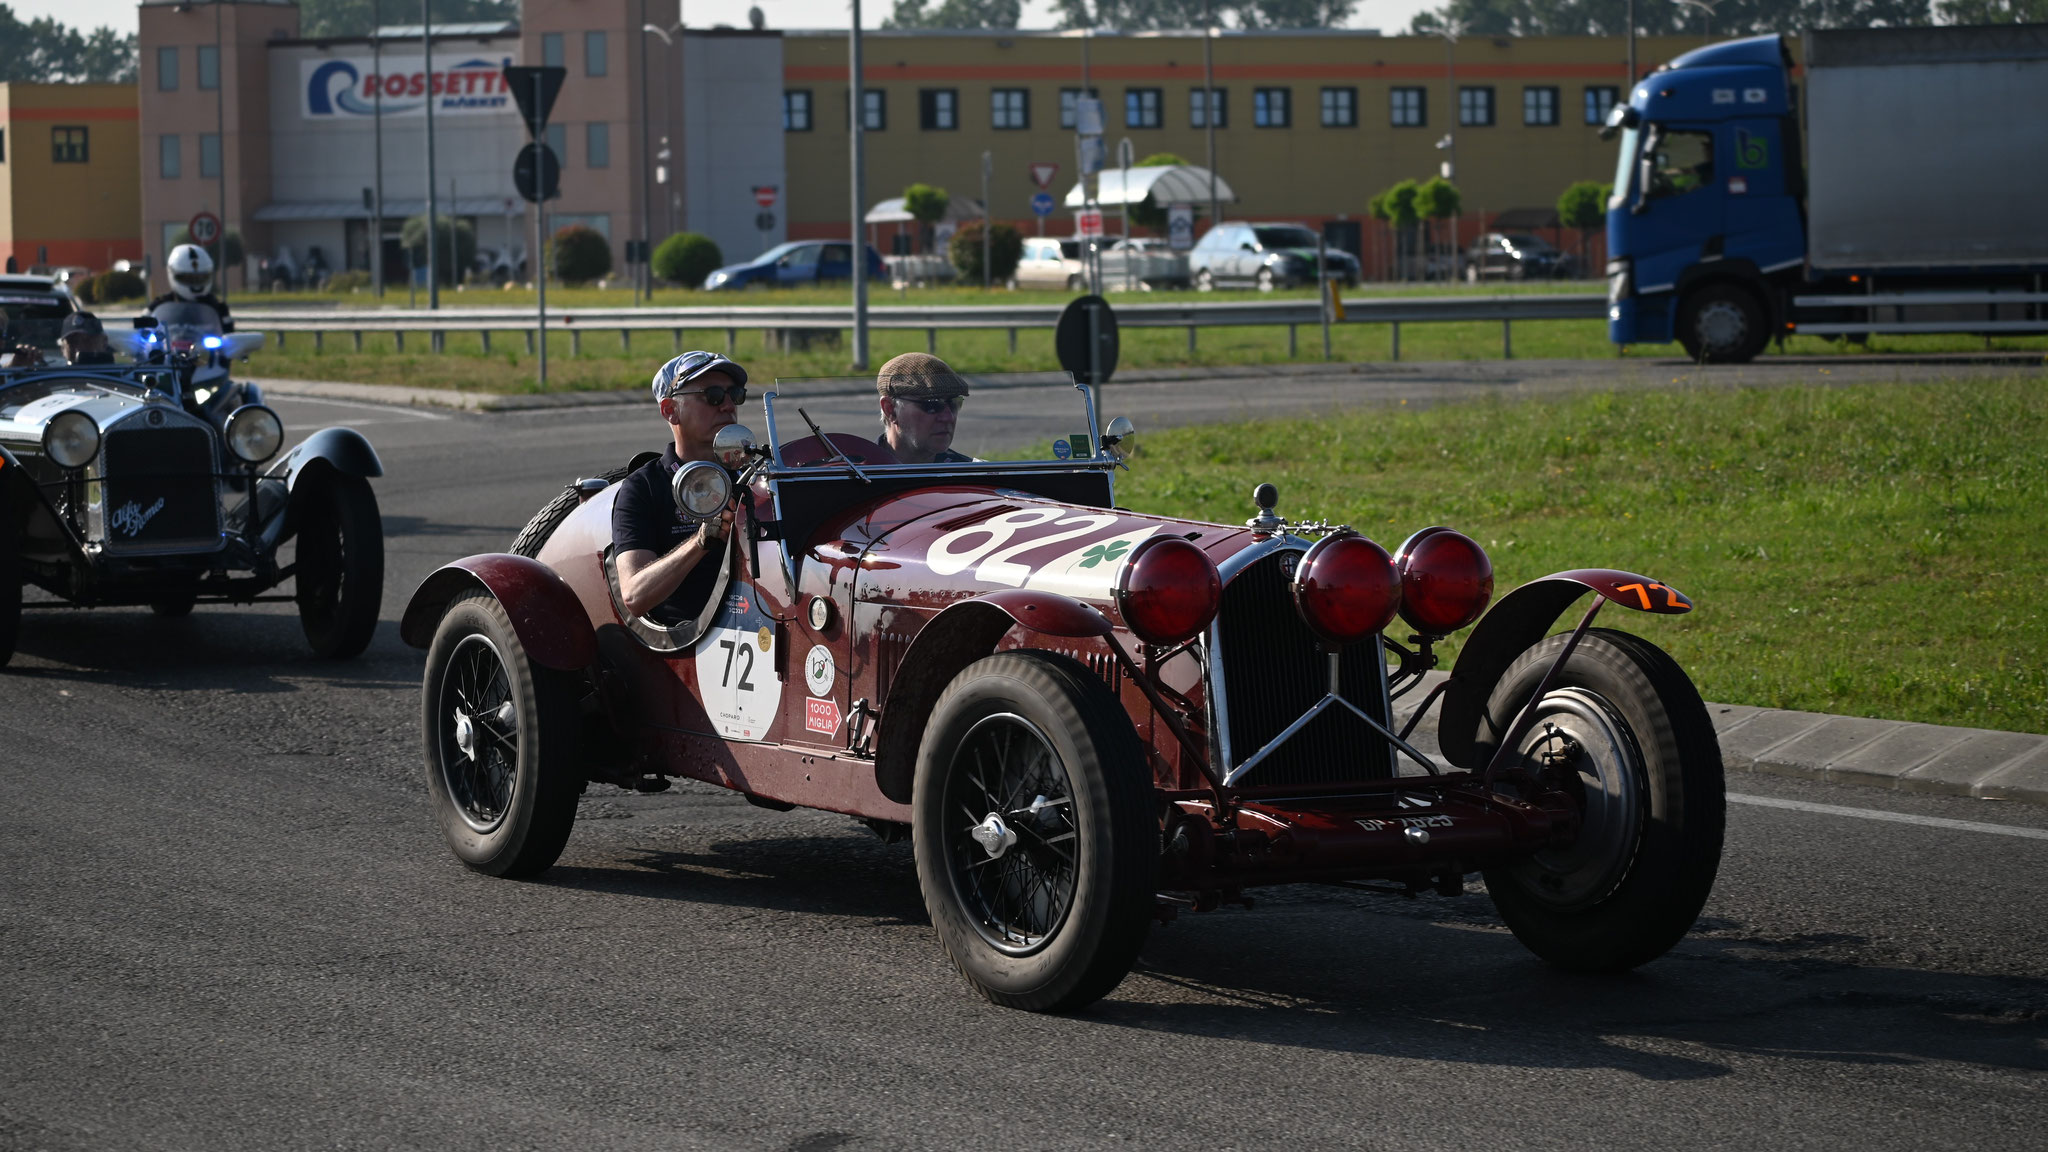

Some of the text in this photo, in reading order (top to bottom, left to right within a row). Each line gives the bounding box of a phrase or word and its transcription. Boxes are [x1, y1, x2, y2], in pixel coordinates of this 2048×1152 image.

[1615, 582, 1692, 610] 72
[719, 639, 755, 692] 72
[810, 702, 832, 716] 1000
[808, 715, 834, 730] MIGLIA
